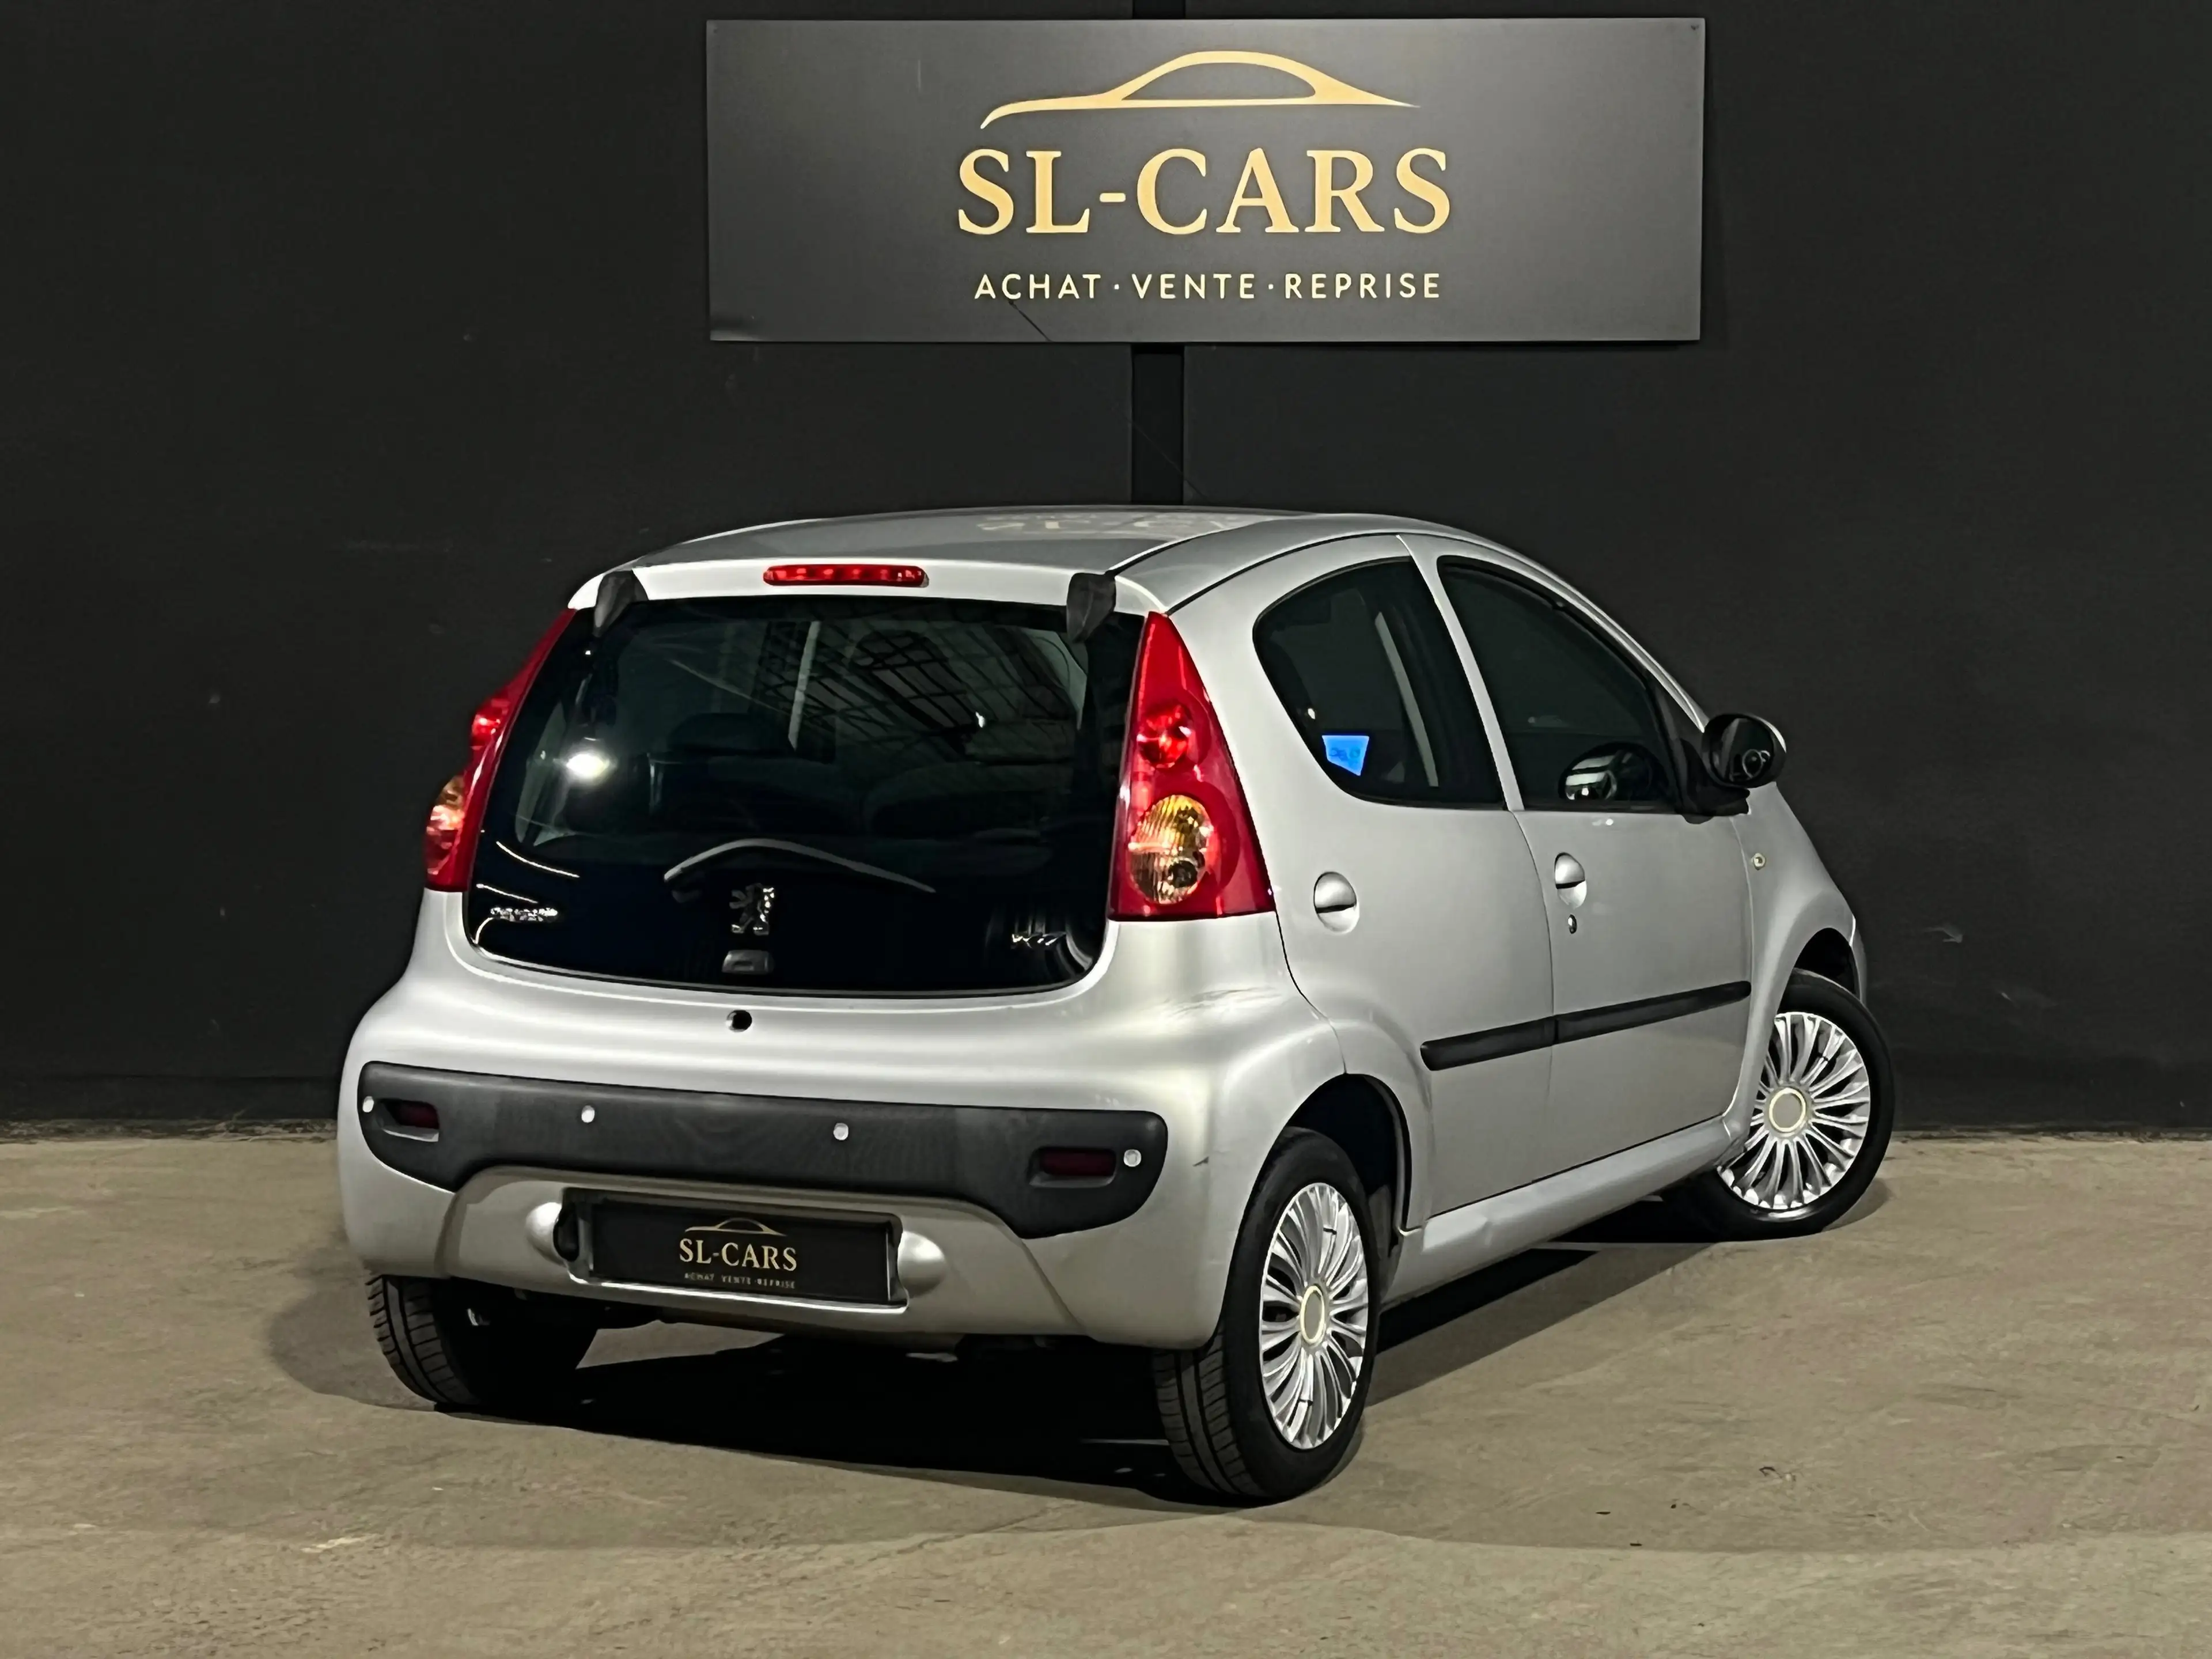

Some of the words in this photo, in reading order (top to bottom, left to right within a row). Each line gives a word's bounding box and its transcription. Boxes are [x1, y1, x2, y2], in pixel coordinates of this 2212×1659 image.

[957, 147, 1450, 236] SL-CARS
[974, 273, 1101, 300] ACHAT
[1131, 273, 1256, 300] VENTE
[1284, 272, 1440, 300] REPRISE
[679, 1238, 798, 1272] SL-CARS
